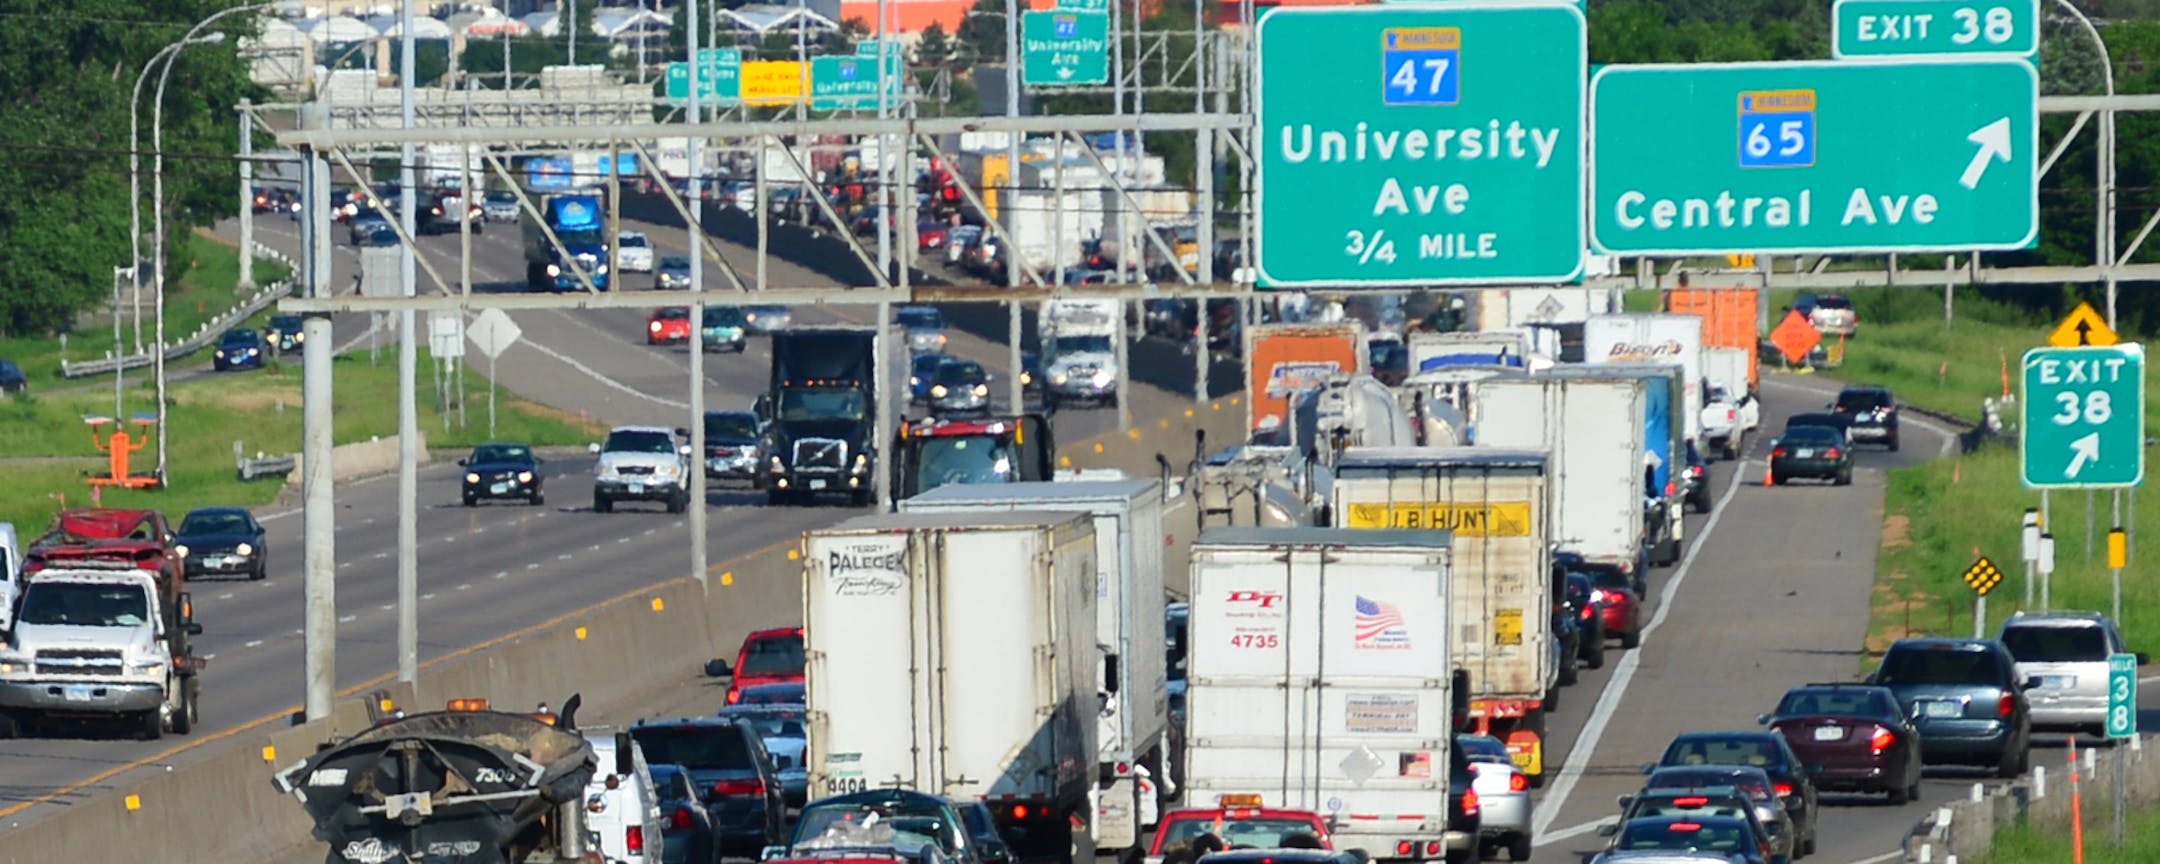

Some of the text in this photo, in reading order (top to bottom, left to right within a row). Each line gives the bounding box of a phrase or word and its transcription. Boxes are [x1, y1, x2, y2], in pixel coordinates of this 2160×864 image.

[1856, 8, 2014, 44] EXIT 38
[1027, 38, 1103, 53] University
[1390, 58, 1450, 96] 47
[1281, 119, 1560, 168] University
[1746, 121, 1805, 157] 65
[1373, 178, 1470, 216] Ave
[1616, 188, 1938, 229] Central Ave
[1344, 230, 1498, 265] 3/4 MILE
[2039, 358, 2126, 384] EXIT
[2052, 390, 2112, 426] 38
[1432, 510, 1490, 530] HUNT
[851, 544, 884, 554] TERRY
[1231, 634, 1278, 648] 4735
[2109, 659, 2135, 672] MILE
